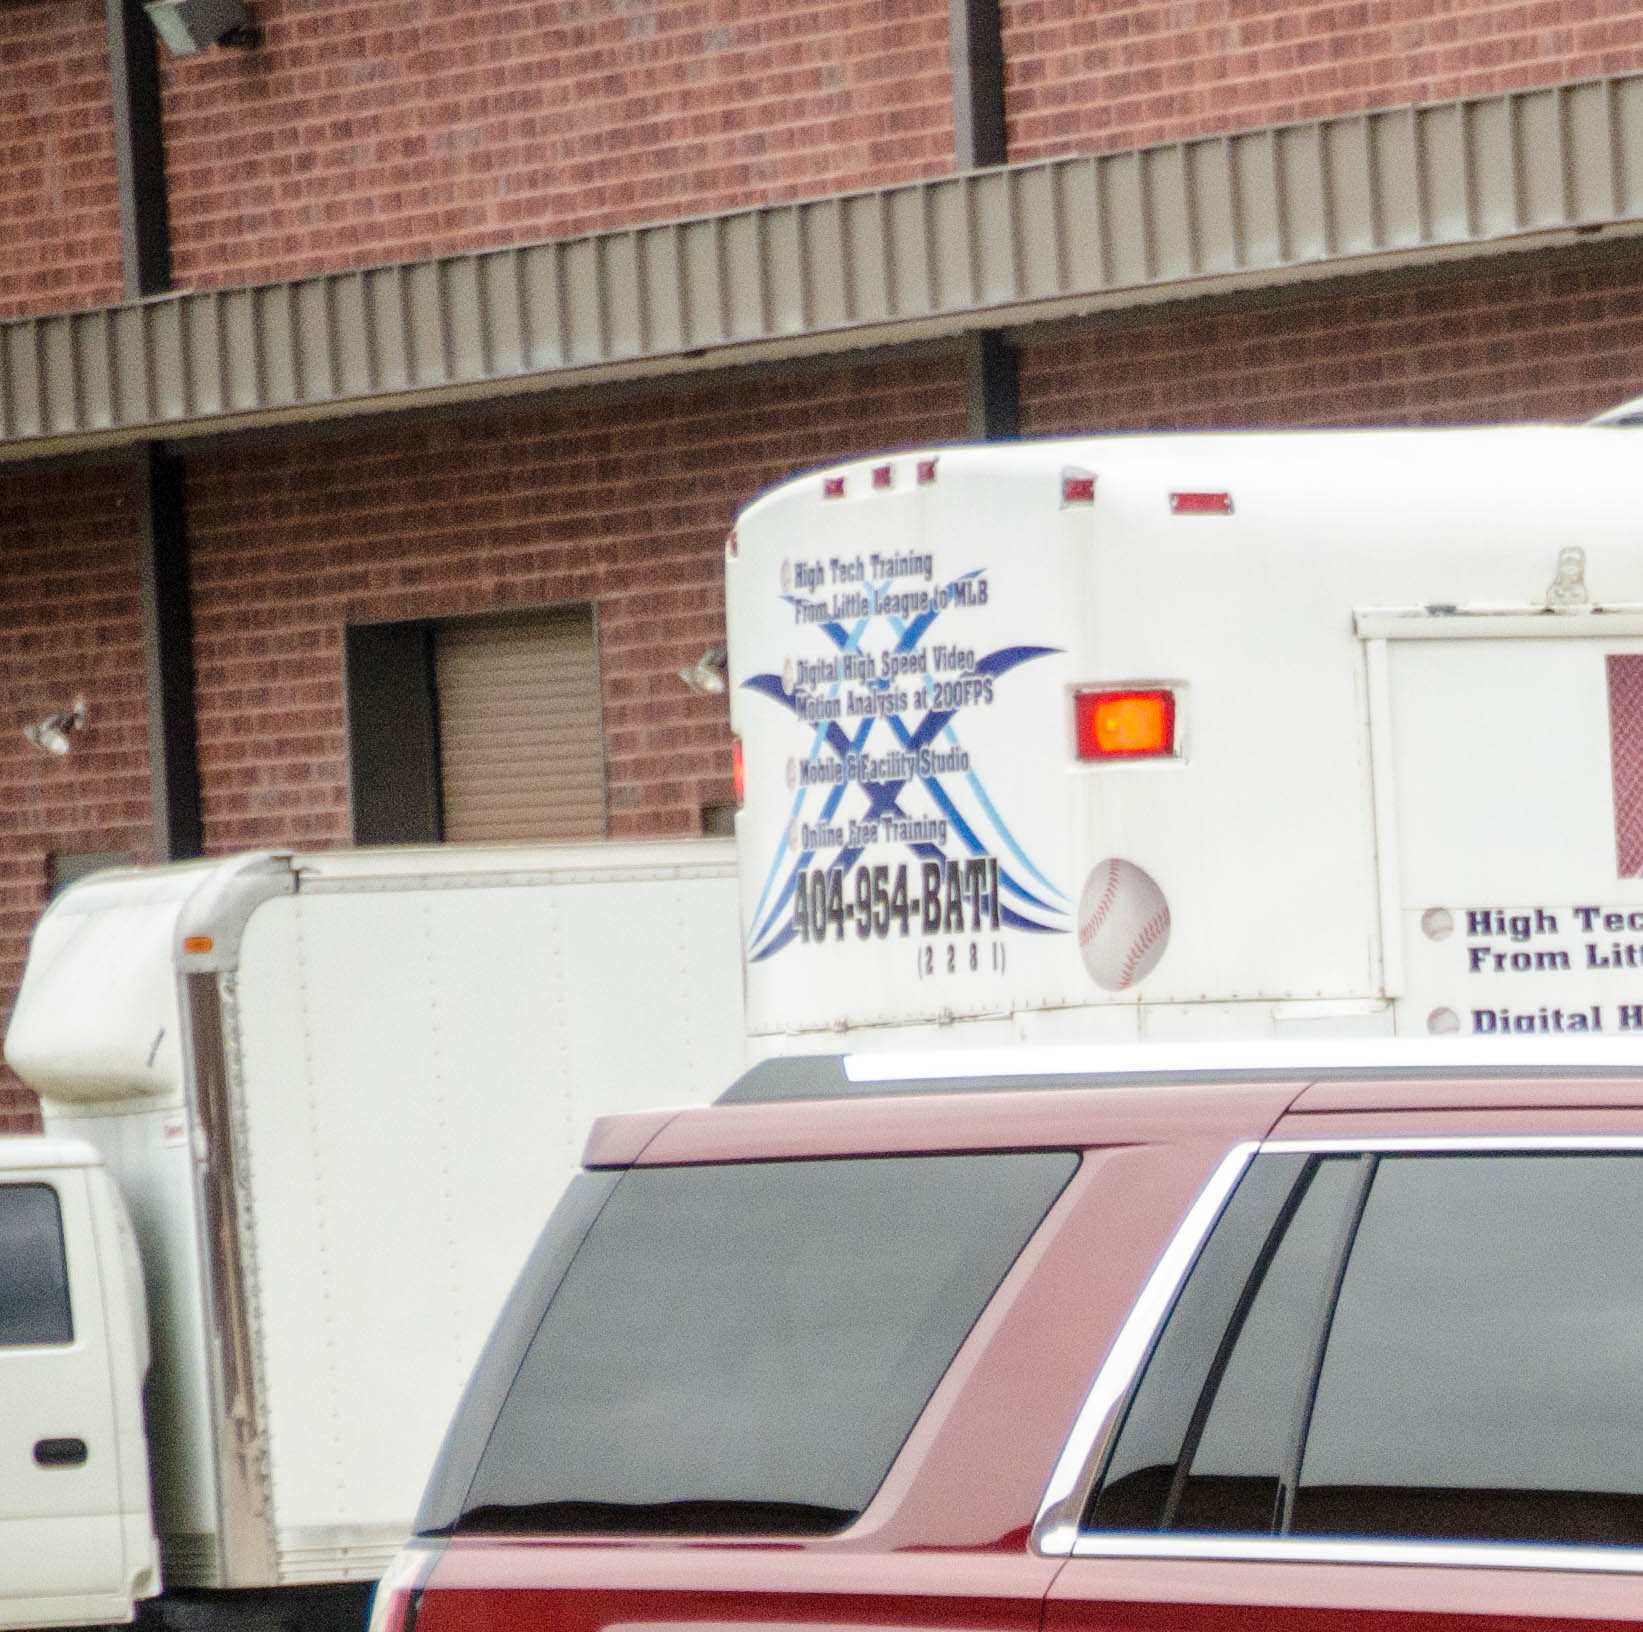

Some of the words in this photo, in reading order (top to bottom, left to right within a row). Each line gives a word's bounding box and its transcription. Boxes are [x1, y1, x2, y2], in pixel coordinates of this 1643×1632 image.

[795, 560, 825, 594] High
[830, 556, 864, 583] Tech
[870, 550, 933, 580] Training
[795, 598, 828, 624] From
[833, 592, 869, 619] Little
[874, 590, 929, 619] League
[933, 585, 948, 610] to
[954, 579, 989, 607] MLB
[797, 656, 838, 690] Digital
[843, 652, 875, 686] High
[881, 647, 927, 682] Speed
[932, 643, 975, 672] Video
[796, 694, 841, 722] Motion
[847, 683, 908, 718] Analysis
[914, 689, 929, 710] at
[932, 678, 994, 710] 200FPS
[799, 759, 843, 786] Mobile
[861, 747, 915, 782] Facility
[921, 747, 969, 775] Studio
[801, 822, 844, 849] Online
[849, 818, 878, 848] Free
[881, 815, 947, 846] Training
[1466, 908, 1559, 942] High
[1467, 946, 1571, 974] From
[1471, 1005, 1603, 1034] Digital
